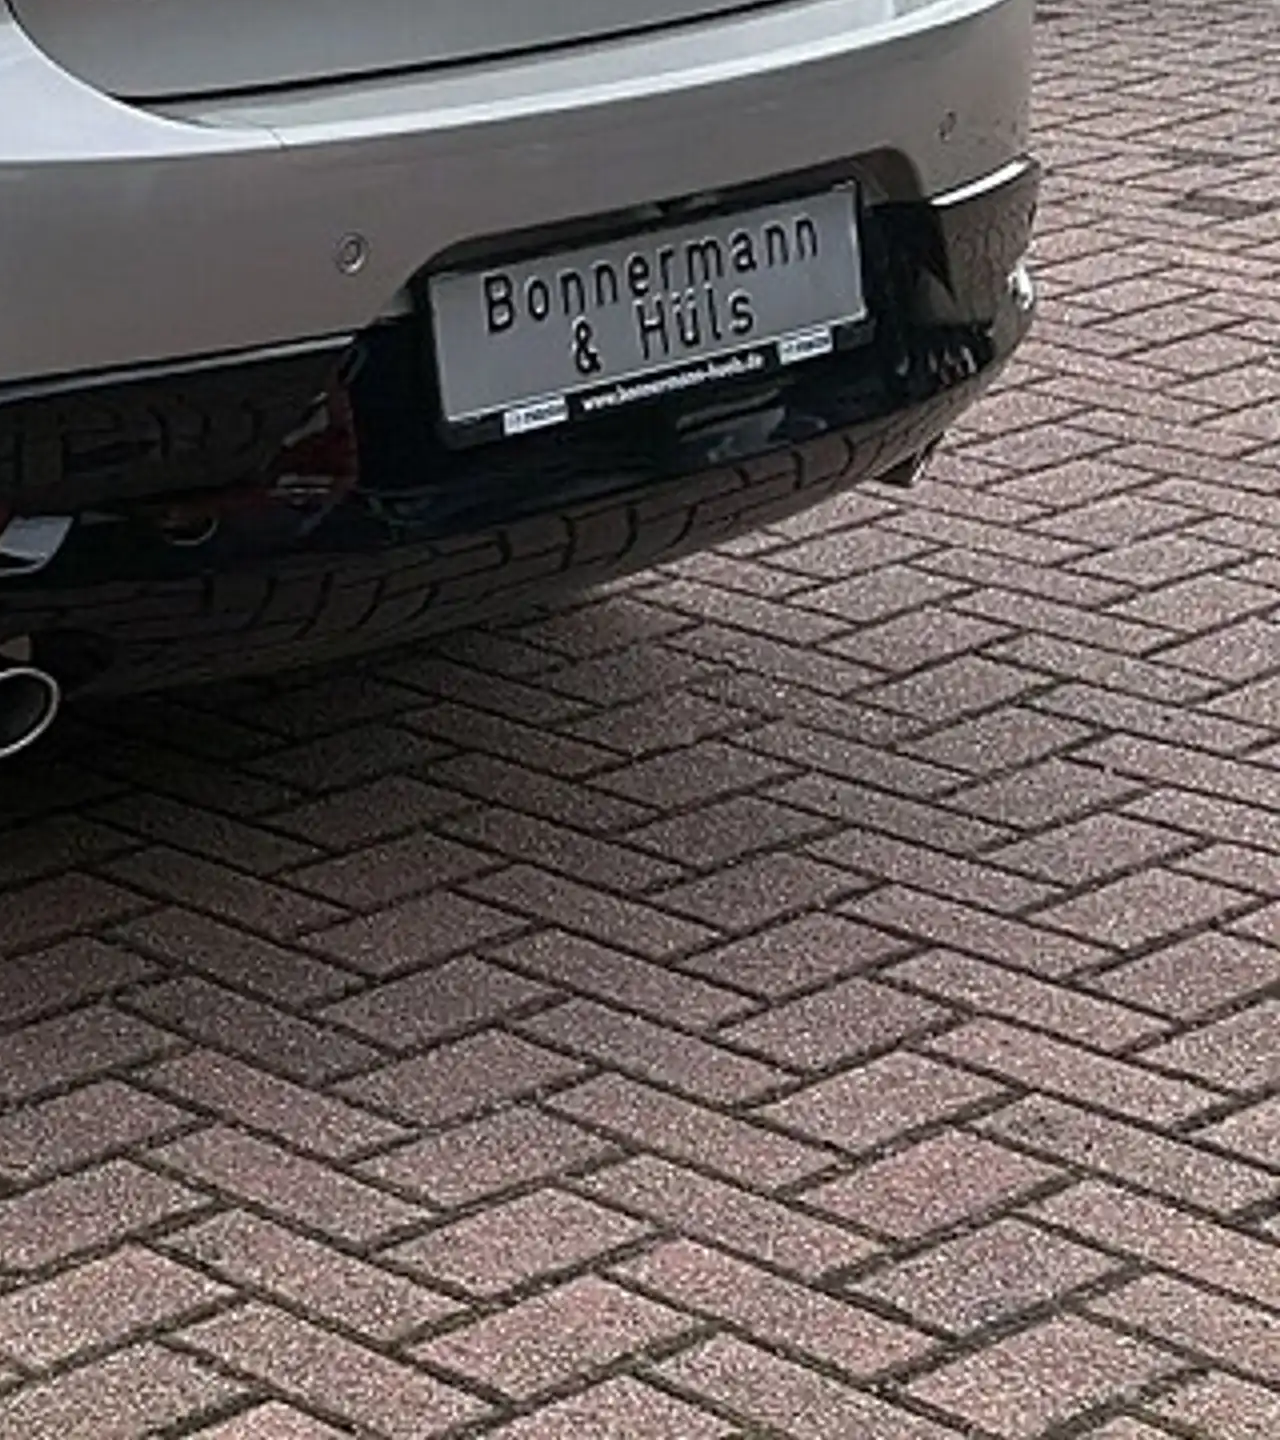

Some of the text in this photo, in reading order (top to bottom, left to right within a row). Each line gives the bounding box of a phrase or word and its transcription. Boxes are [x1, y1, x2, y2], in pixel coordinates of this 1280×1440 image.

[483, 216, 819, 335] Bonnermann
[572, 317, 601, 374] &
[637, 288, 755, 359] Hüls
